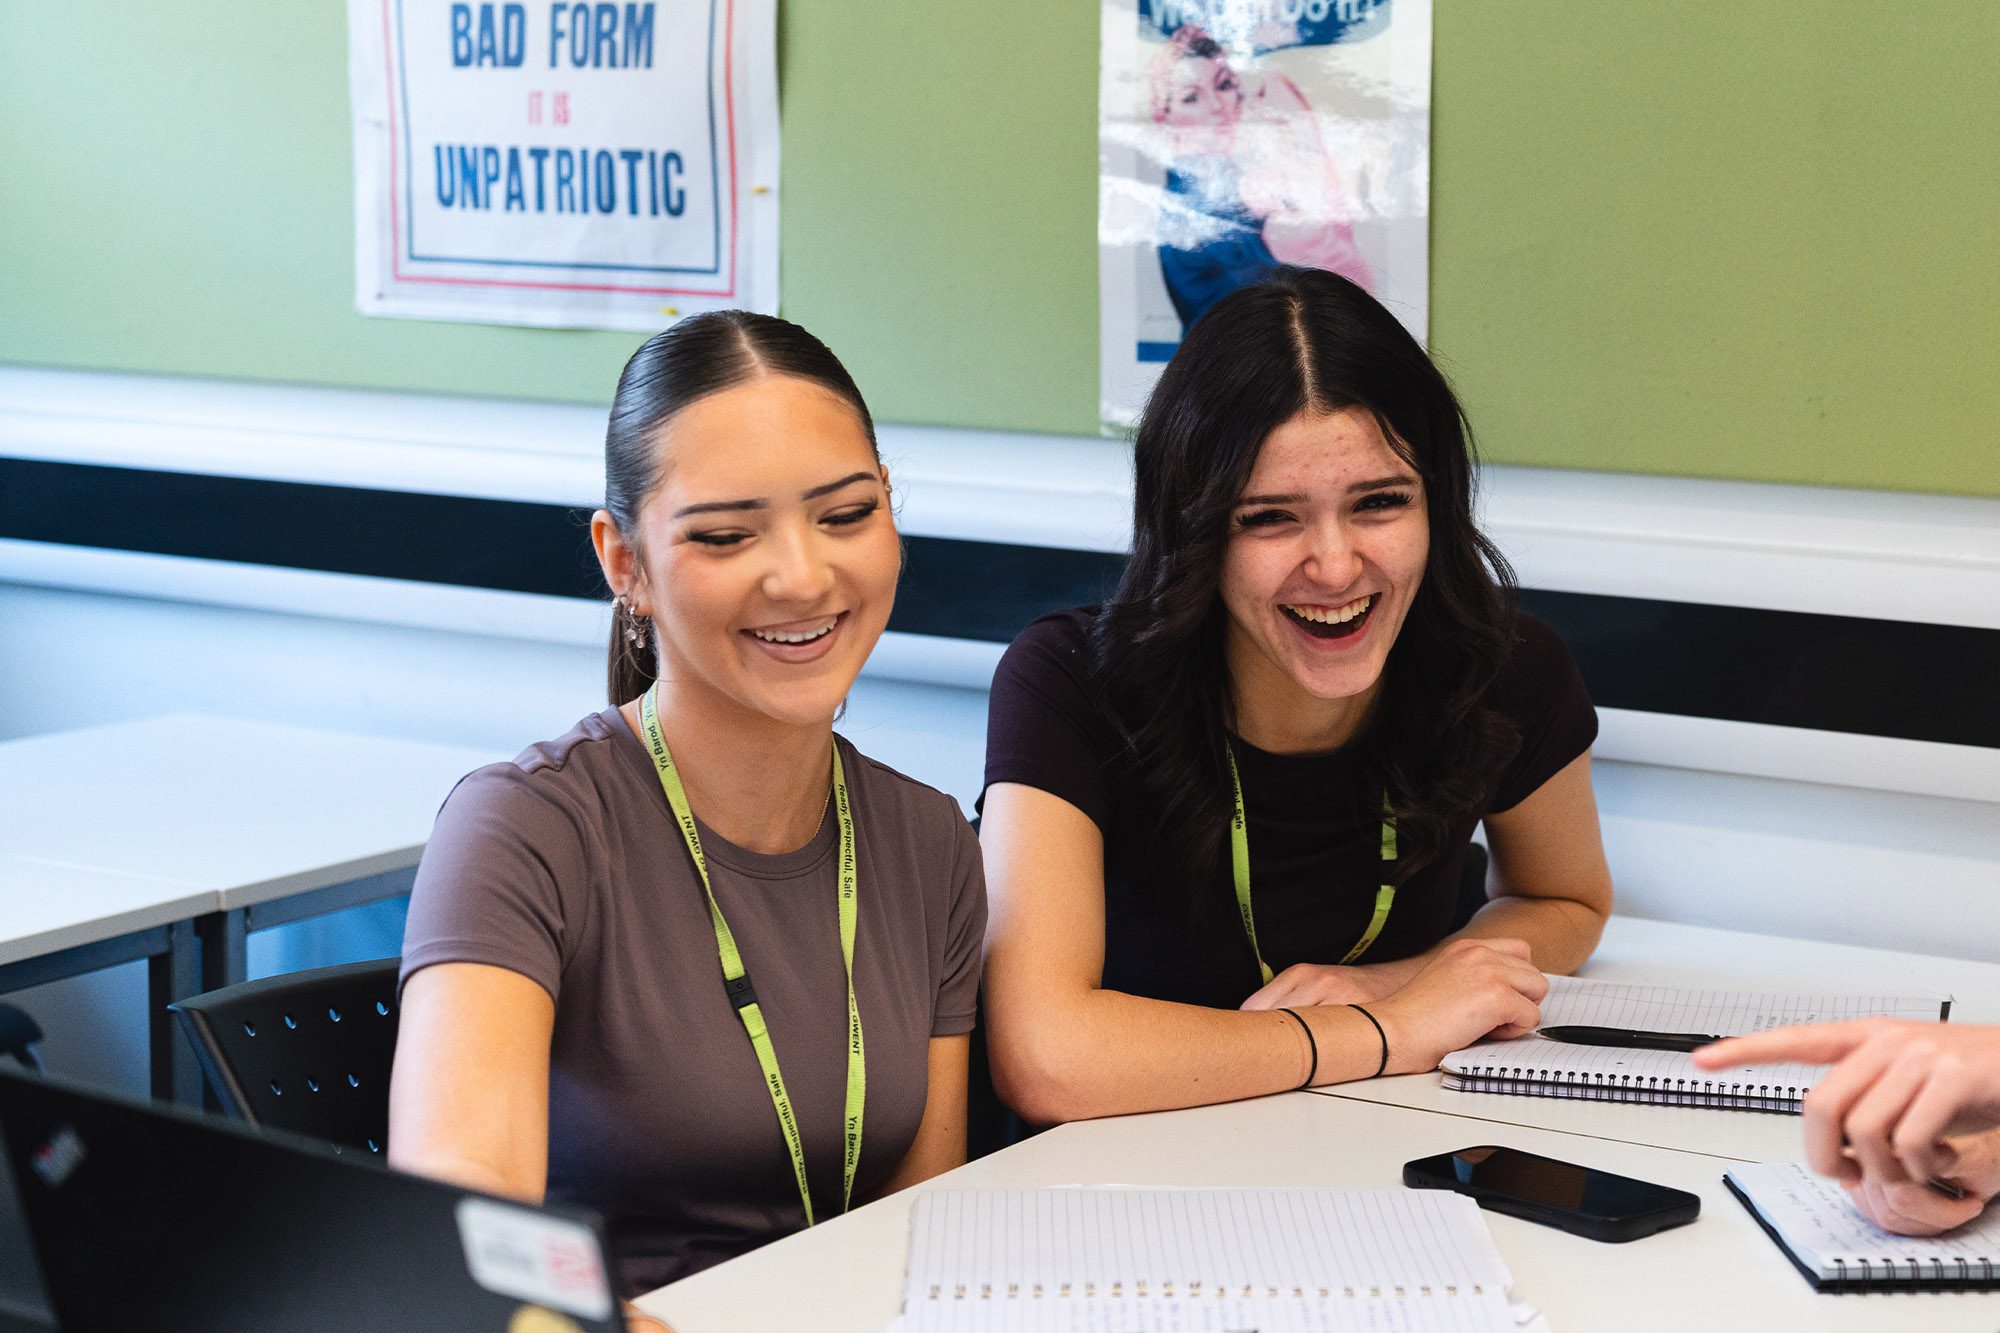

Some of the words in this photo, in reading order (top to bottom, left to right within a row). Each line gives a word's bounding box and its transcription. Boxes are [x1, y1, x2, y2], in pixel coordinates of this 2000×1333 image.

[451, 3, 526, 68] BAD
[549, 3, 656, 69] FORM
[528, 91, 543, 126] IT
[553, 92, 571, 127] IS
[434, 144, 686, 217] UNPATRIOTIC
[647, 722, 664, 755] Barod,
[659, 756, 670, 771] Yn
[838, 784, 848, 815] Ready,
[681, 815, 701, 854] GWENT
[843, 818, 854, 873] Respectful,
[843, 876, 853, 899] Safe
[852, 1015, 860, 1056] GWENT
[770, 1073, 782, 1097] Safe
[848, 1116, 857, 1130] Yn
